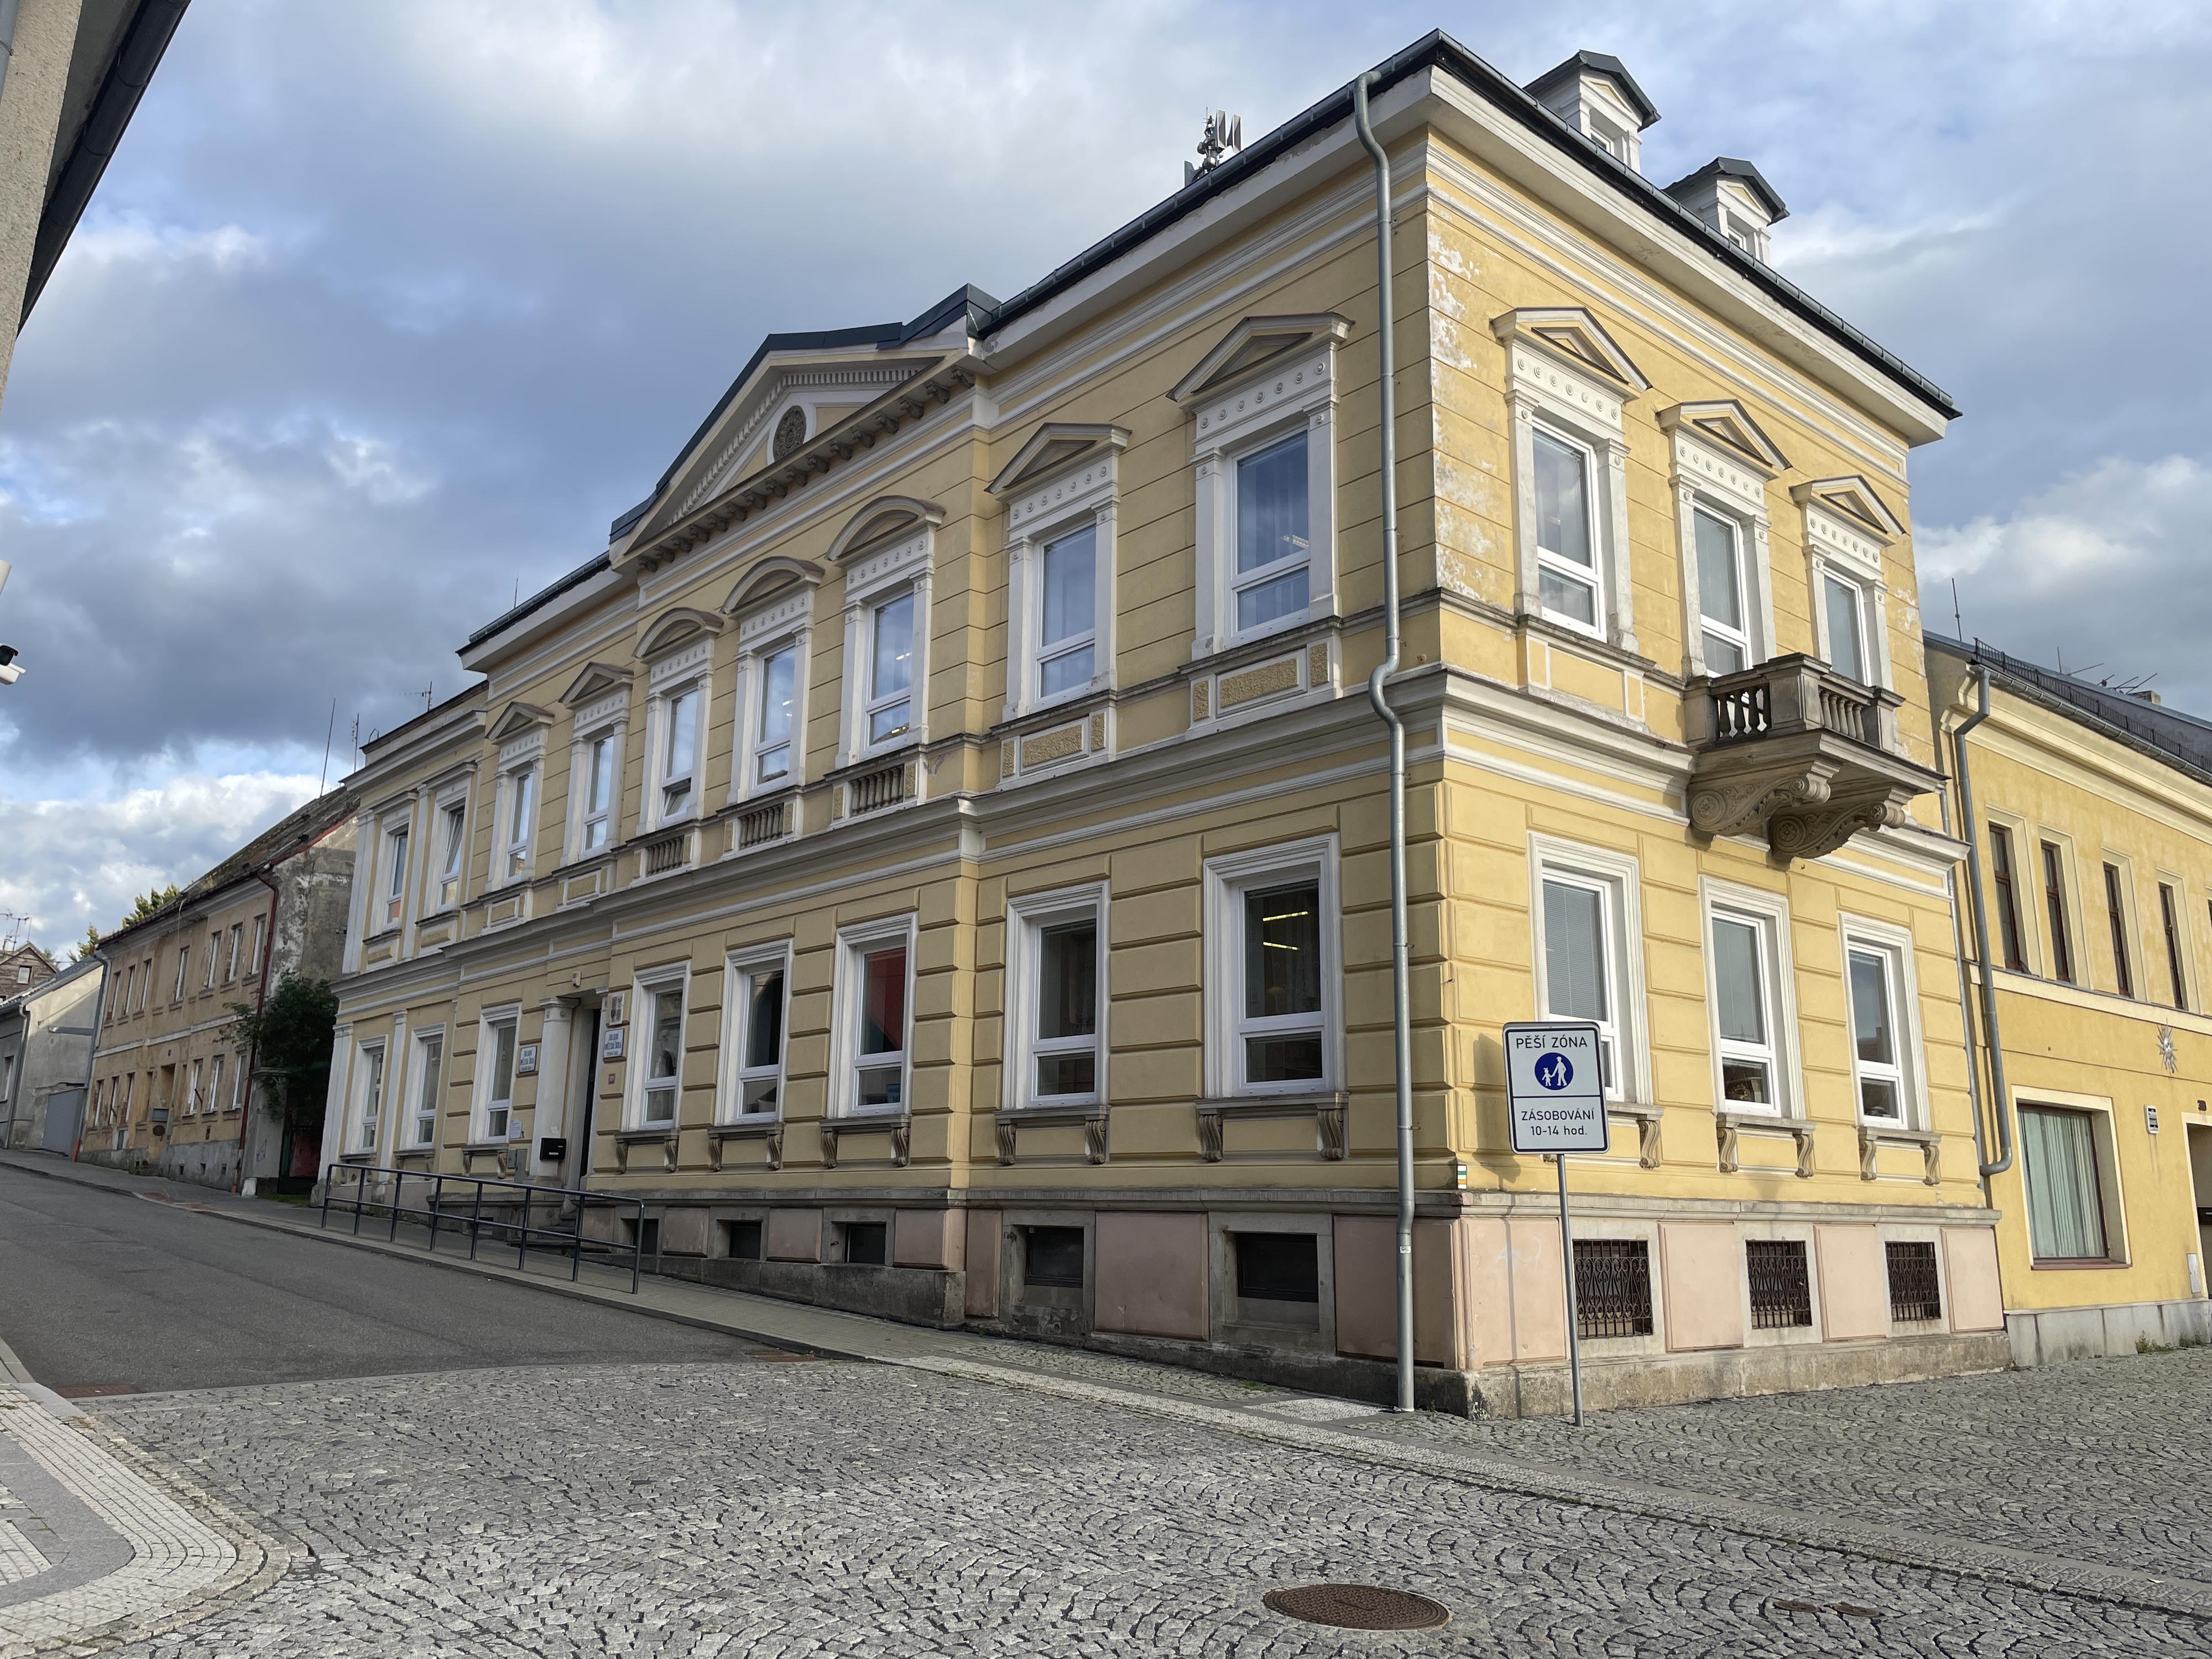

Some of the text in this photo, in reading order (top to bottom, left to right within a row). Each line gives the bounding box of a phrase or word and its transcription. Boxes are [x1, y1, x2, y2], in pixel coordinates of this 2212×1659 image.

[1516, 1034, 1588, 1049] PĚŠÍ ZÓNA
[1521, 1107, 1595, 1121] ZÁSOBOVÁNÍ
[1531, 1125, 1588, 1136] 10-14 hod.
